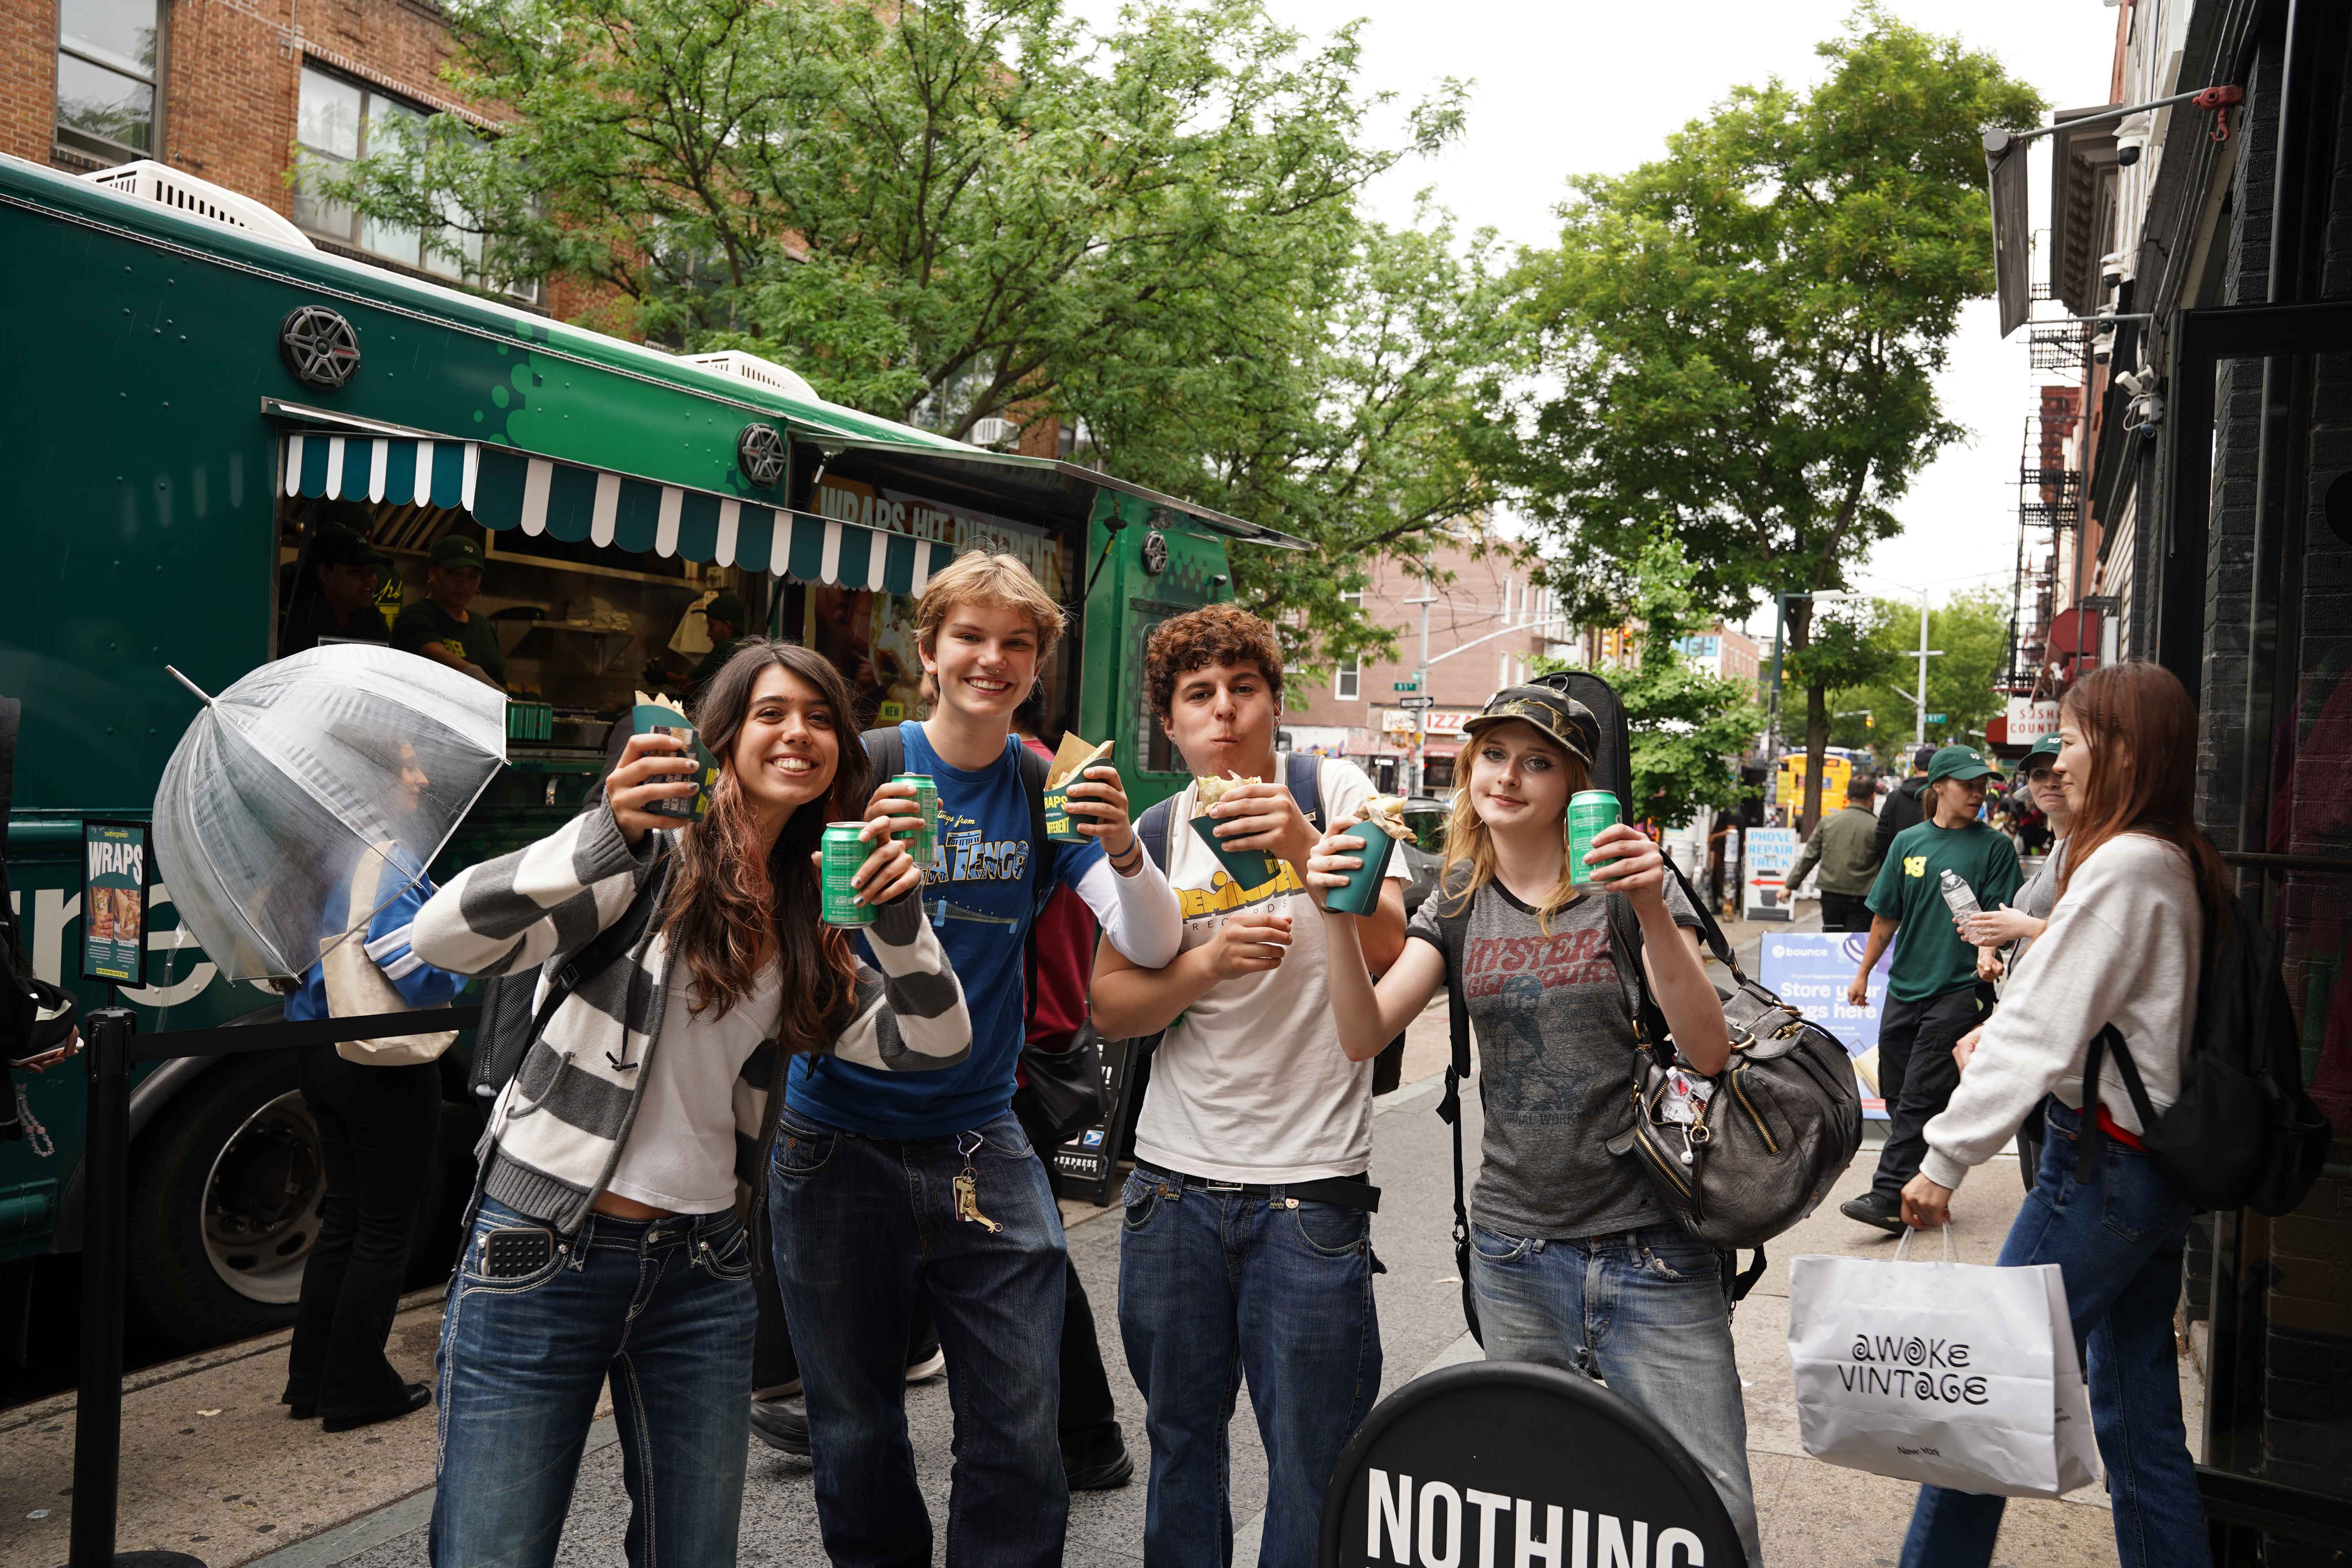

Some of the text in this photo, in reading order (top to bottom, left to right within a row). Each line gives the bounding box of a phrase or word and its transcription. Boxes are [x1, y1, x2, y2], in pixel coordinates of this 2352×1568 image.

[885, 706, 899, 717] NEW
[1044, 795, 1068, 811] RAPS
[954, 815, 976, 828] from
[1750, 831, 1791, 842] PHONE
[1748, 844, 1793, 855] REPAIR
[89, 841, 143, 886] WRAPS
[922, 829, 1029, 886] ATENGO
[1750, 857, 1789, 867] TRUCK
[1786, 947, 1828, 957] bounce
[1780, 982, 1881, 1002] Store yur
[1796, 1003, 1878, 1022] ags here
